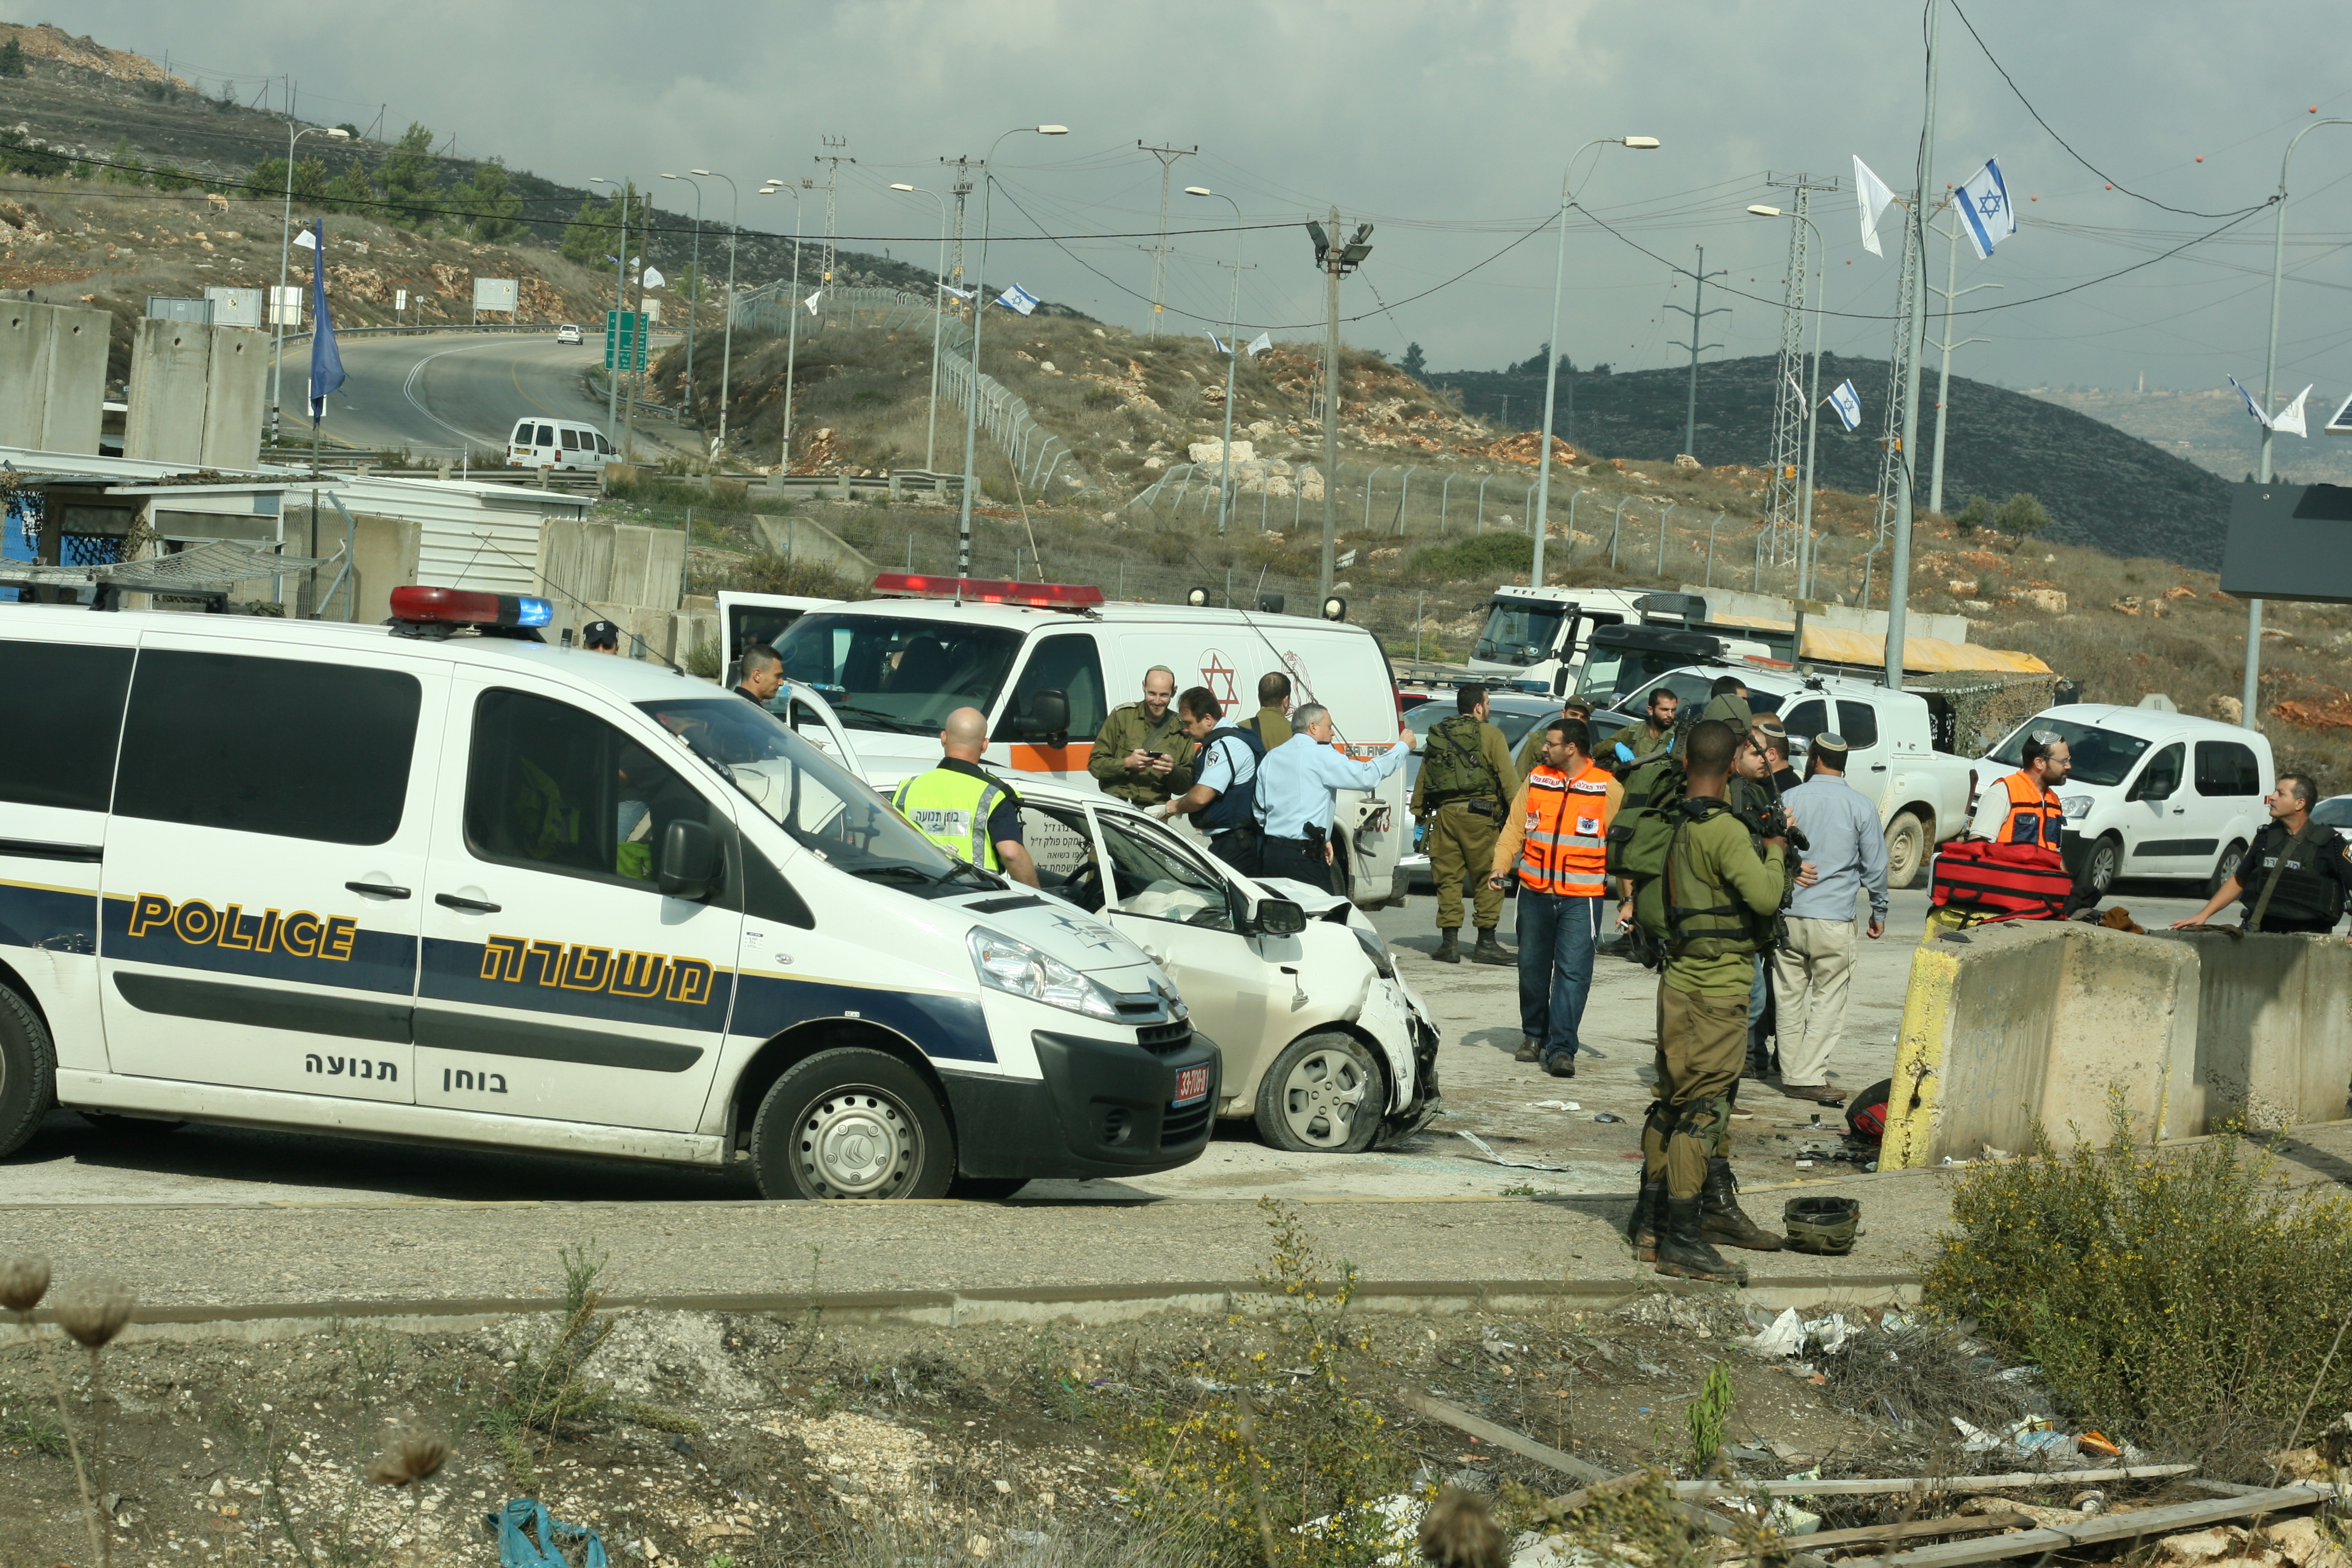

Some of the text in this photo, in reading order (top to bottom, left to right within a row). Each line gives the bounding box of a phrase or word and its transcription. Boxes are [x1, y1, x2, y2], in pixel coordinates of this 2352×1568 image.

[915, 811, 959, 825] בוחן תנועה
[1044, 836, 1060, 848] פולק
[1050, 863, 1079, 872] משפחת
[128, 892, 359, 962] POLICE
[480, 933, 715, 1005] משטרה
[305, 1053, 508, 1094] בוחן תנועה
